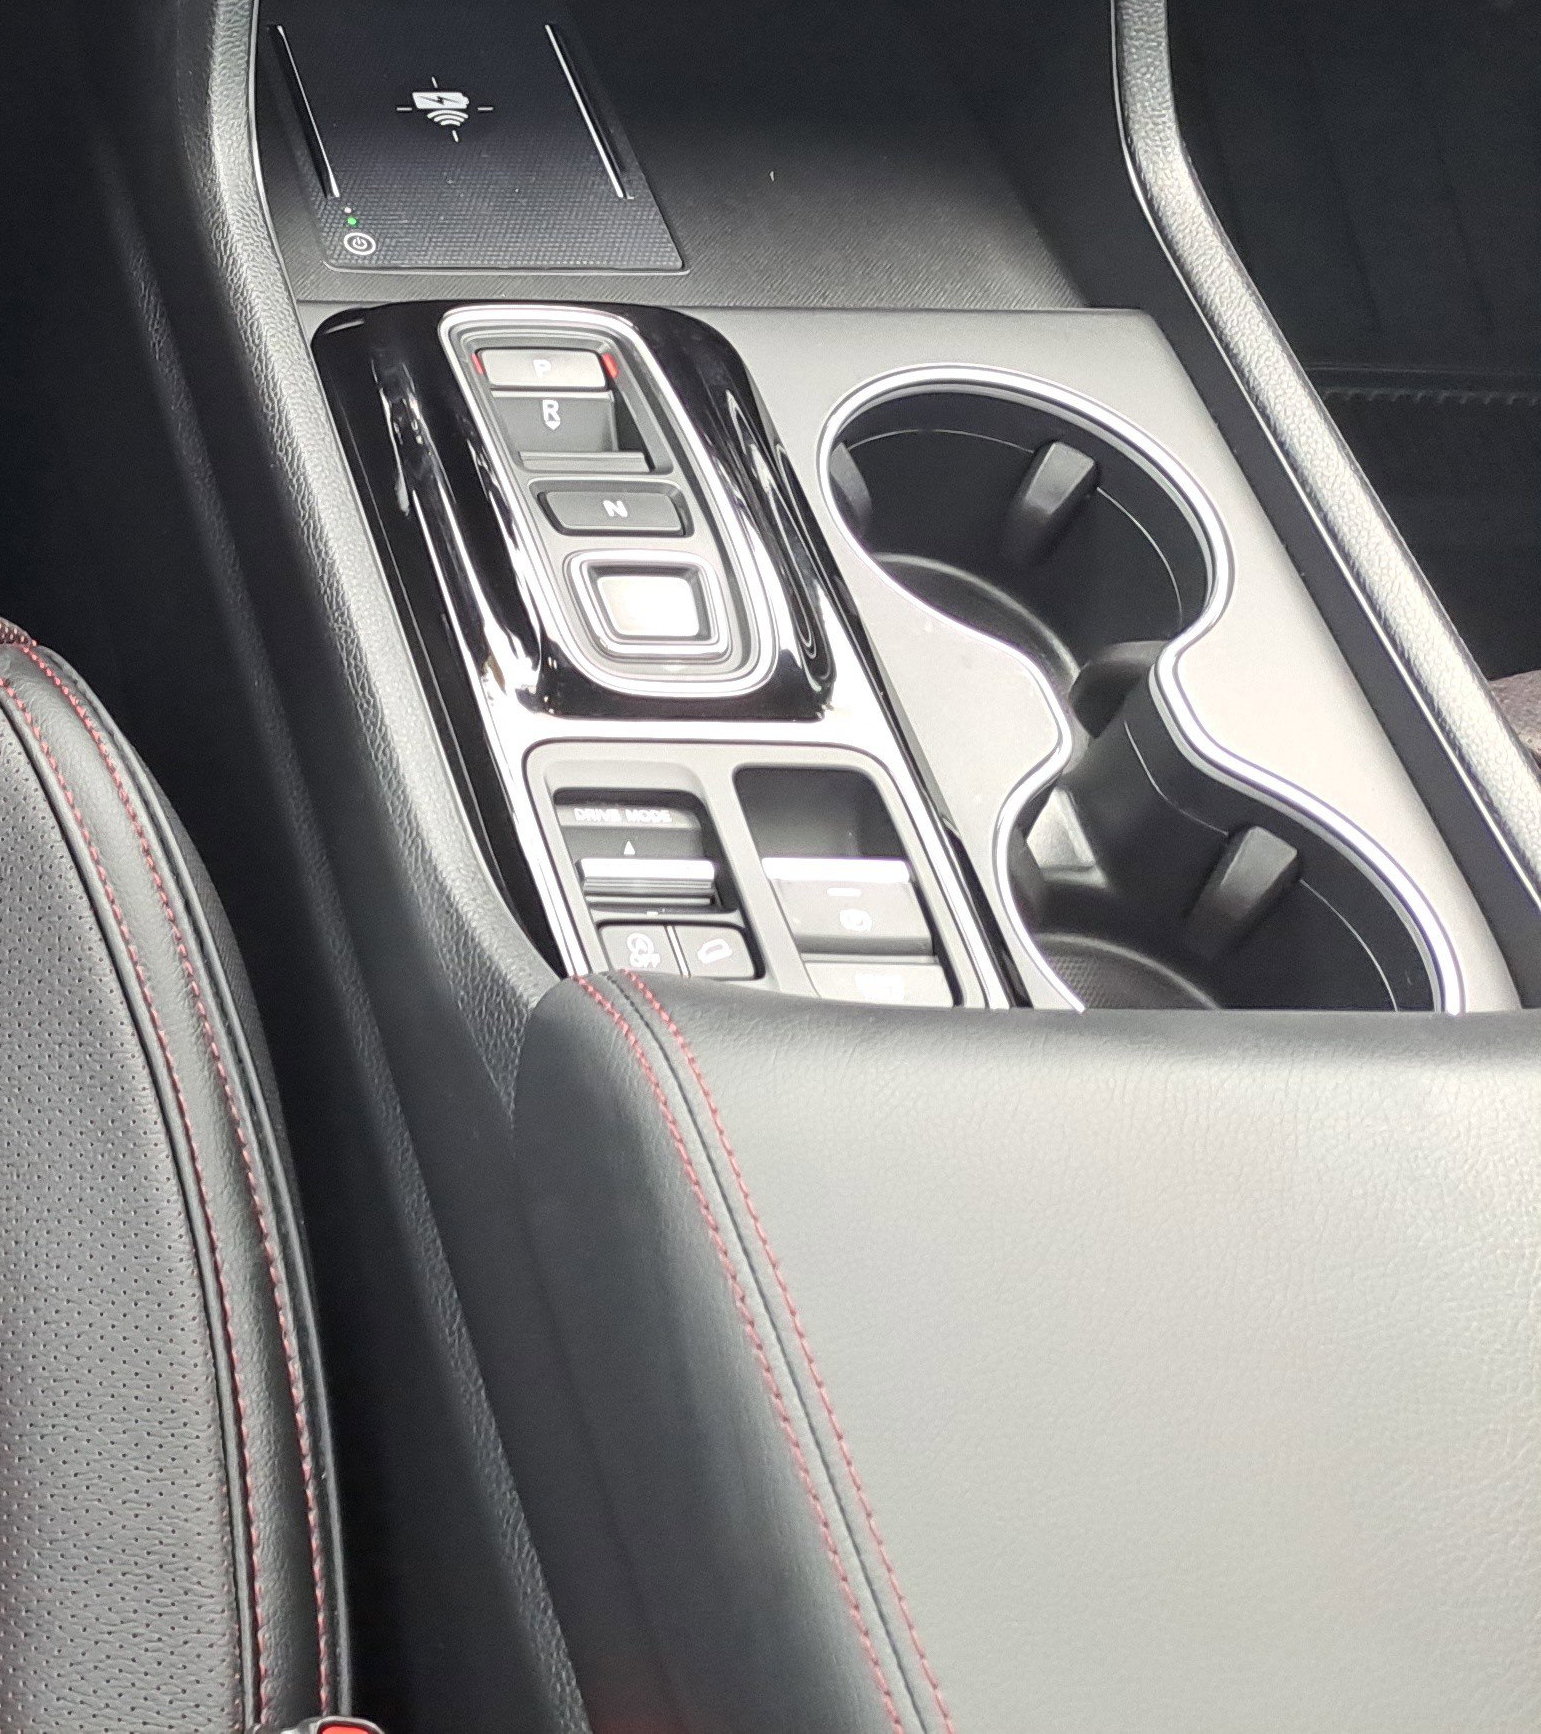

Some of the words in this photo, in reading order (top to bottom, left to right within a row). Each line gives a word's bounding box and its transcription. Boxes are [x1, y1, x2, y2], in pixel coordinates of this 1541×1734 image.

[534, 359, 552, 379] P
[541, 398, 559, 421] R
[602, 499, 629, 518] N
